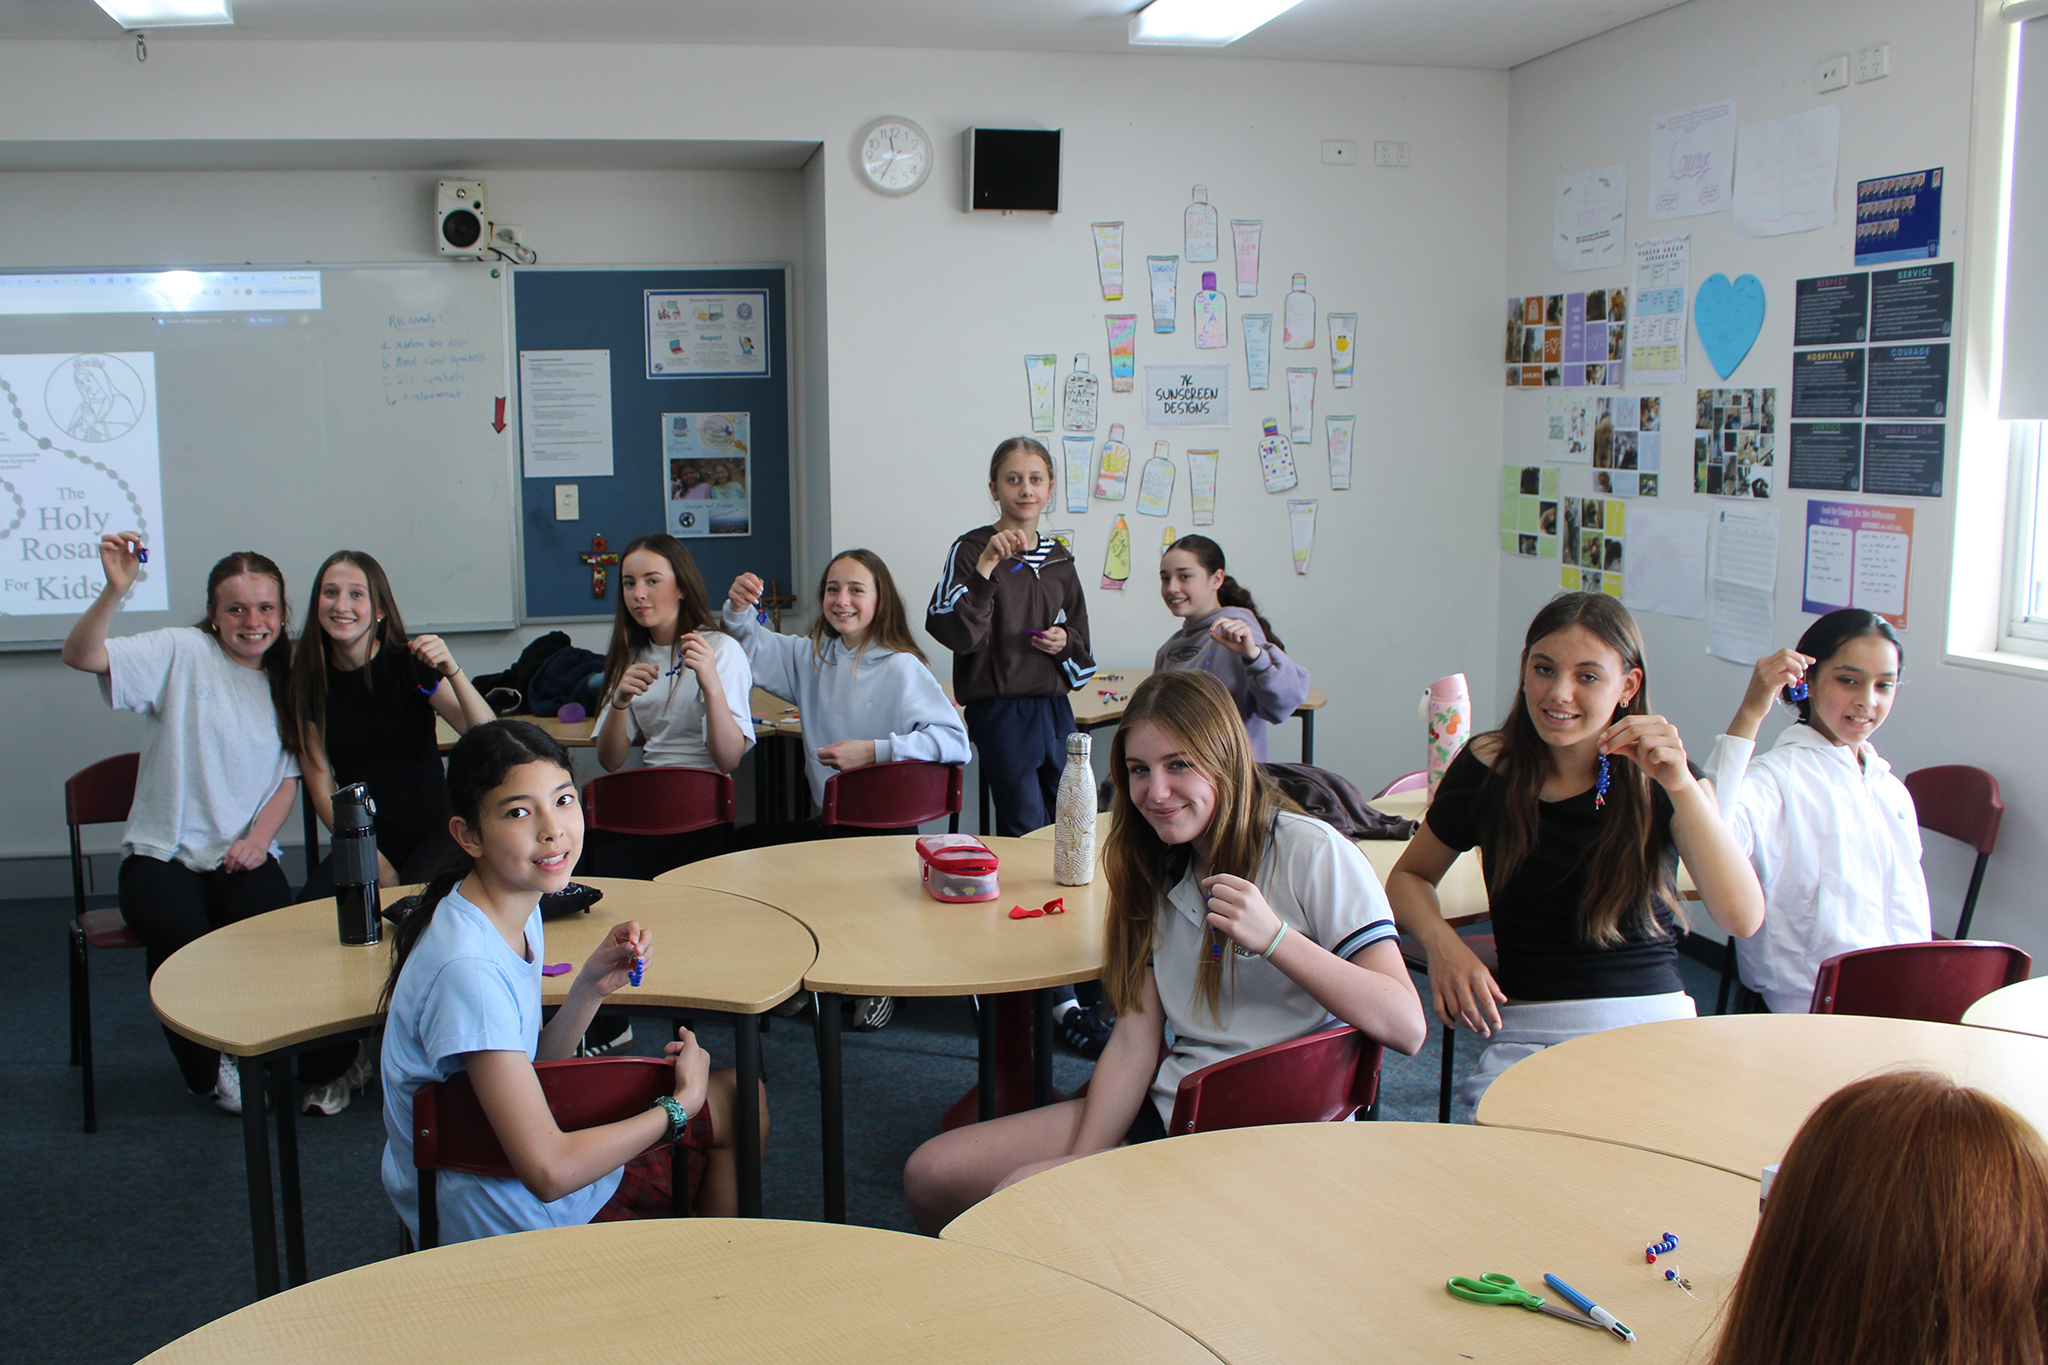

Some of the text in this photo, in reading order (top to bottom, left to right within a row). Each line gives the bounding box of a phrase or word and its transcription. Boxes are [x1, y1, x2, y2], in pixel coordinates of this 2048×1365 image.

[880, 129, 887, 139] 11
[889, 127, 900, 138] 12
[868, 138, 880, 150] 10
[911, 139, 918, 150] 2
[865, 150, 873, 161] 9
[915, 152, 922, 163] 3
[910, 164, 917, 174] 4
[890, 174, 897, 185] 6
[902, 172, 909, 182] 5
[1897, 268, 1933, 280] SERVICE
[1817, 276, 1849, 287] RESPECT
[1806, 351, 1855, 361] HOSPITALITY
[1891, 347, 1931, 357] COURAGE
[1180, 373, 1193, 387] 7K
[1155, 387, 1219, 401] SUNSCREEN
[1164, 401, 1210, 414] DESIGNS
[1812, 422, 1841, 431] JUSTICE
[1878, 425, 1934, 435] COMPASSION
[56, 487, 86, 500] The
[1821, 505, 1830, 514] Lead
[1871, 510, 1896, 520] Difference
[37, 505, 111, 536] Holy
[1861, 521, 1880, 530] ACTIONS
[19, 537, 101, 561] Rosar
[4, 579, 30, 592] For
[34, 574, 103, 601] Kids
